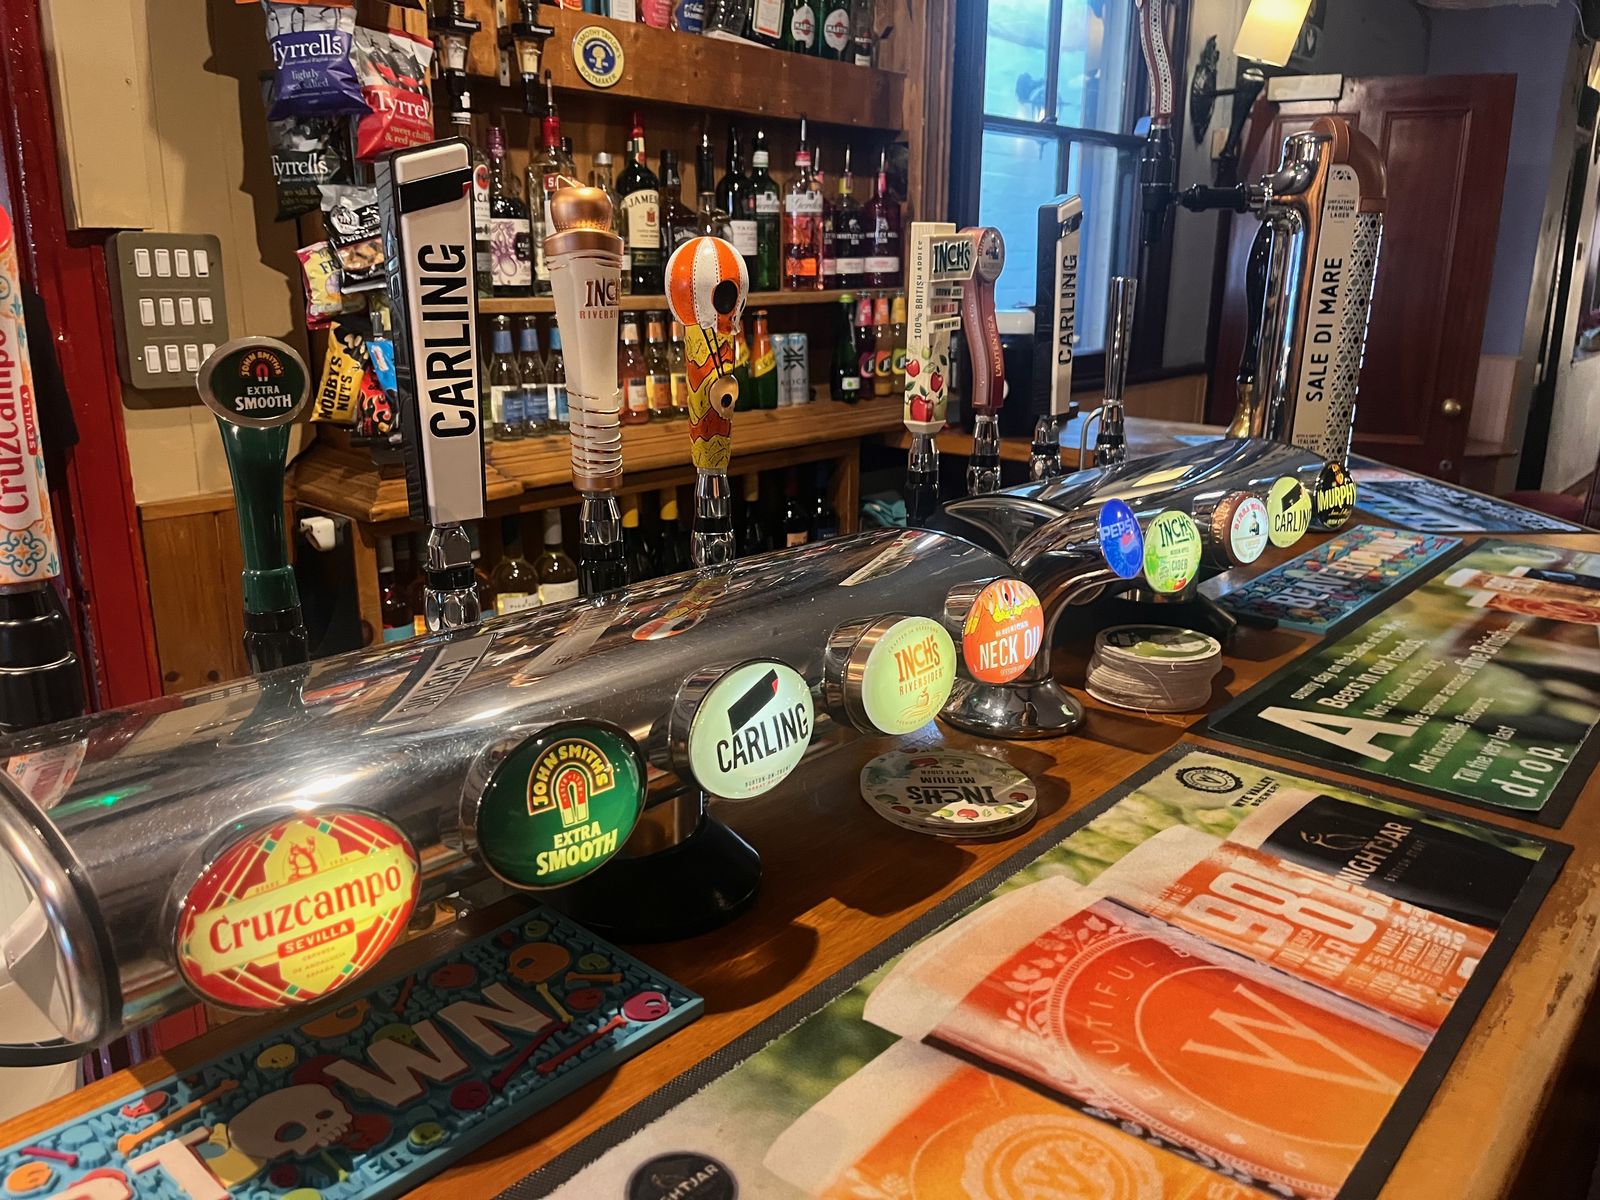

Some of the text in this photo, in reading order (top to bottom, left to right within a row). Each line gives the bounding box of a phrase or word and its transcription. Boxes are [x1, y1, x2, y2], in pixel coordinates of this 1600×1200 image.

[933, 240, 970, 273] INCH'S
[1058, 254, 1077, 366] CARLING
[418, 244, 476, 438] CARLING
[1306, 257, 1343, 402] SALE DI MARE
[241, 353, 257, 376] JOHN
[235, 393, 292, 411] SMOOTH
[246, 385, 280, 396] EXTRA
[336, 374, 353, 412] NUTS
[24, 391, 37, 450] SEVILLA
[1101, 519, 1134, 542] PEPSI
[1171, 559, 1188, 571] CIDER
[895, 634, 941, 683] INCH'S
[980, 633, 1018, 670] NECK
[1316, 683, 1370, 710] Beers
[1349, 675, 1382, 685] in
[1367, 660, 1398, 676] our
[1363, 703, 1390, 718] Not
[1401, 713, 1430, 726] We
[716, 702, 808, 773] CARLING
[1258, 706, 1420, 762] A
[1409, 750, 1441, 773] And
[1452, 725, 1517, 783] Till the very last
[533, 752, 559, 806] JOHN
[558, 744, 614, 786] SMITH'S
[920, 776, 976, 784] MEDIUM
[1232, 794, 1253, 807] WYE
[1246, 776, 1276, 796] VALLEY
[535, 828, 618, 876] SMOOTH
[553, 820, 602, 849] EXTRA
[1335, 822, 1413, 885] NIGHTJAR
[208, 864, 402, 955] Cruzcampo
[284, 922, 349, 955] SEVILLA
[1181, 982, 1403, 1094] W
